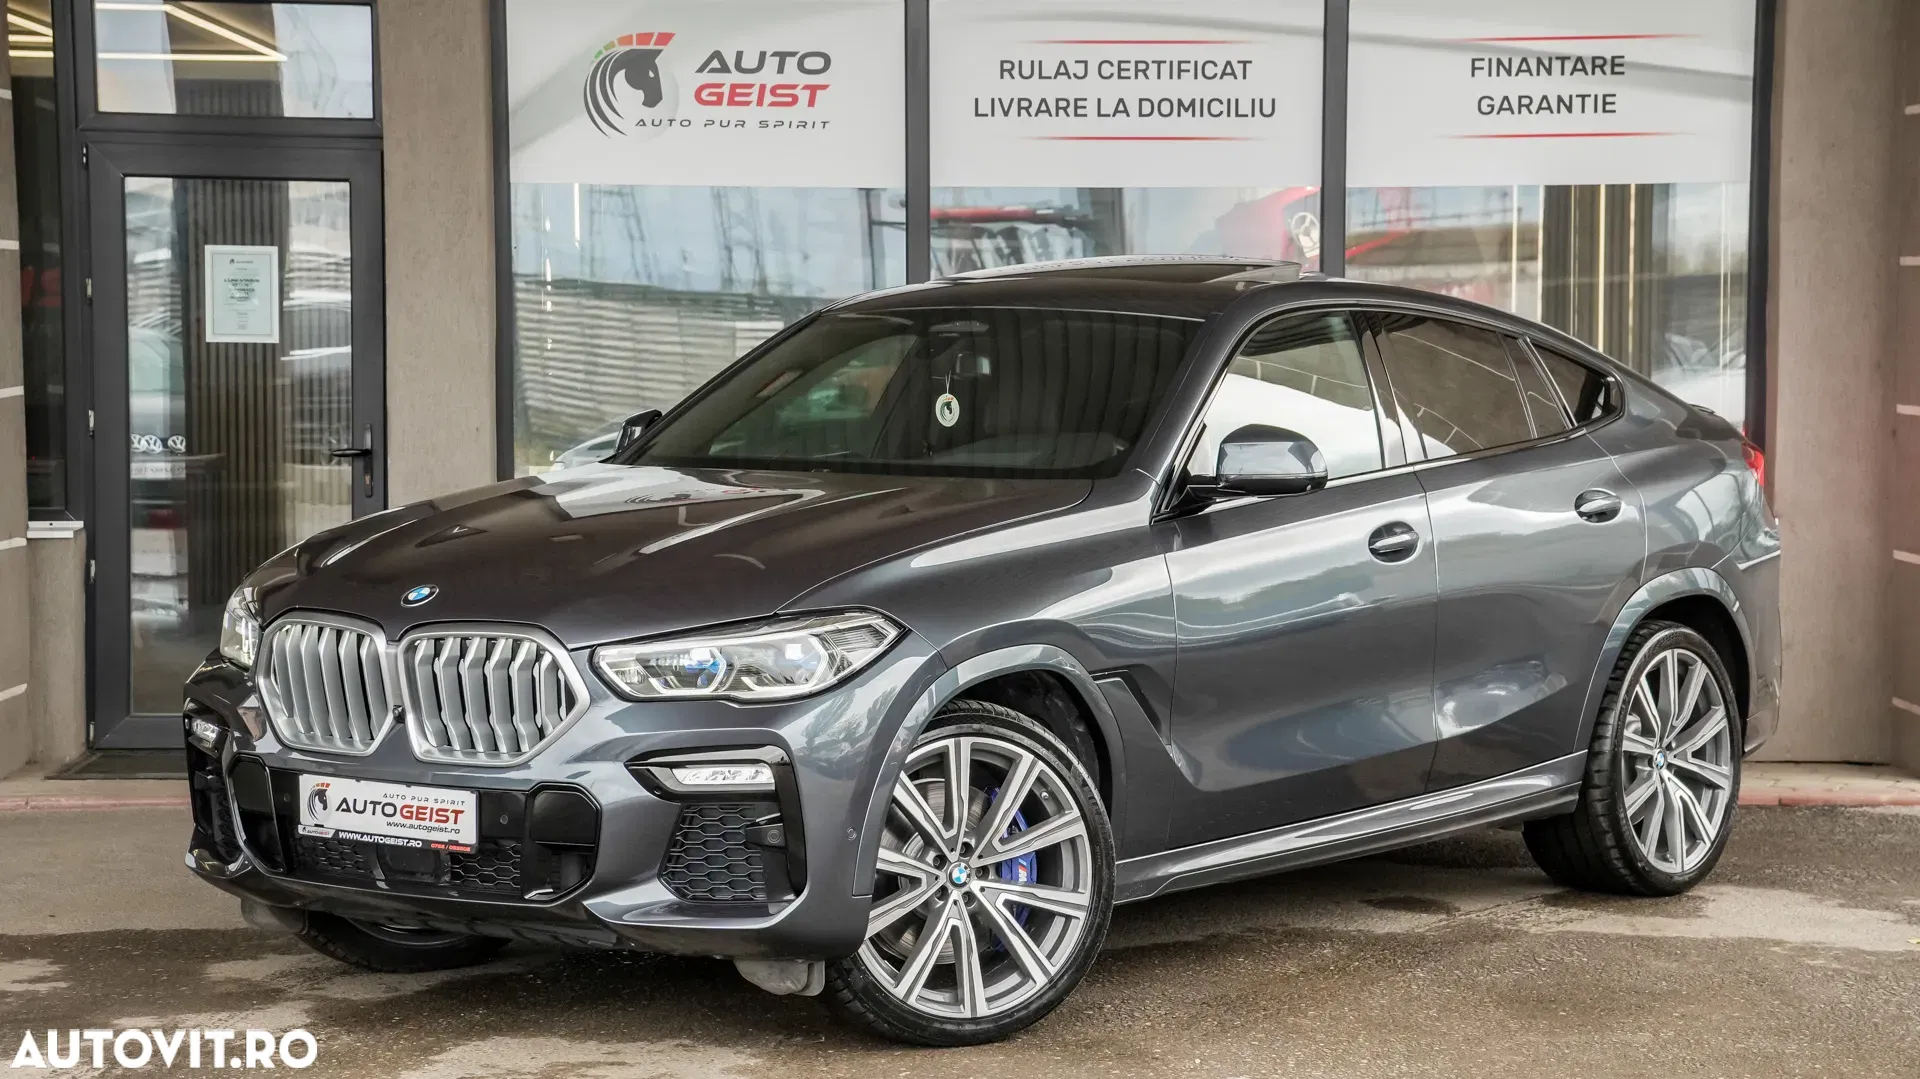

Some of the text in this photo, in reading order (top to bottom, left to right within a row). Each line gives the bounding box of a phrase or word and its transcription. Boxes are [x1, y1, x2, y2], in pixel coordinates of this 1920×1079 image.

[694, 49, 832, 76] AUTO
[999, 59, 1253, 82] RULAJ CERTIFICAT
[1471, 55, 1627, 78] FINANTARE
[694, 83, 830, 108] GEIST
[1477, 93, 1617, 117] GARANTIE
[974, 96, 1276, 119] LIVRARE LA DOMICILIU
[634, 117, 831, 130] AUTO PUR SPIRIT
[383, 792, 466, 807] AUTO PUR SPIRIT
[386, 820, 461, 835] www.autogeist.ro
[338, 831, 423, 848] WWW.AUTOGEIST.RO
